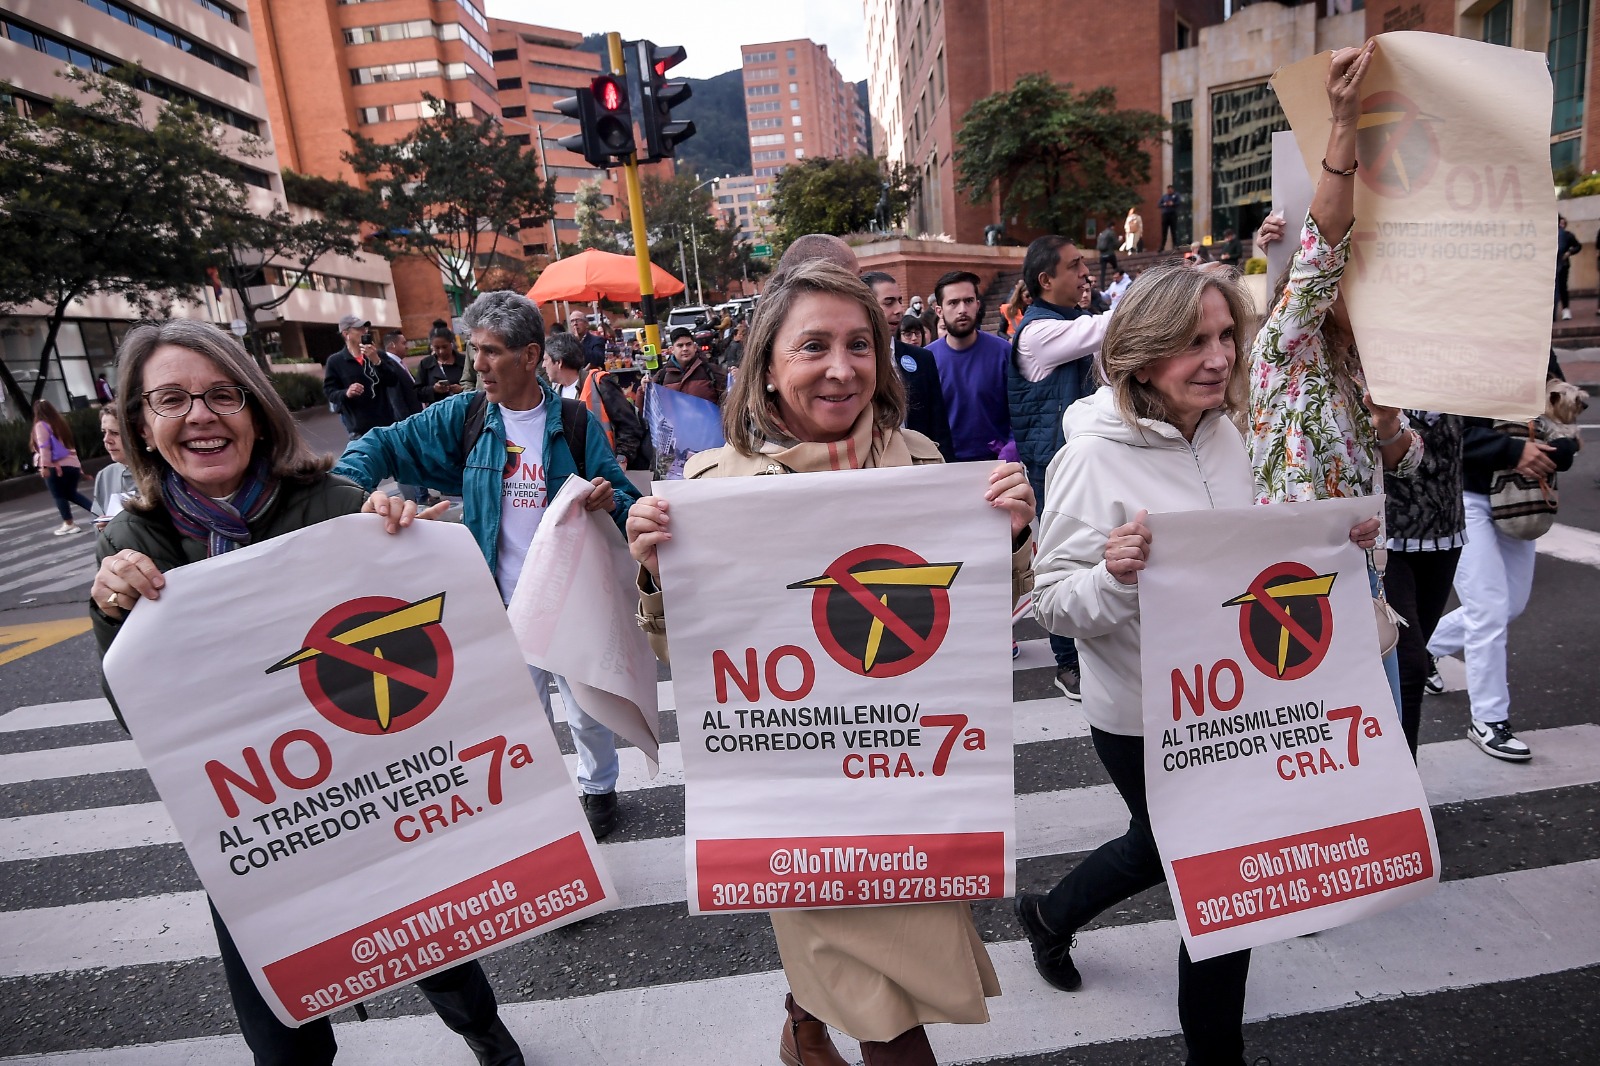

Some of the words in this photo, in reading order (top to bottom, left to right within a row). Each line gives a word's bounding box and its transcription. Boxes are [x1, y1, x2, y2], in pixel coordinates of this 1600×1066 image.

[512, 498, 539, 508] CRA.
[514, 490, 539, 498] VERDE
[712, 644, 816, 704] NO
[1170, 658, 1244, 722] NO
[702, 710, 731, 731] AL
[734, 702, 920, 729] TRANSMILENIO/
[705, 731, 836, 753] CORREDOR
[843, 728, 922, 749] VERDE
[1161, 727, 1184, 749] AL
[1185, 699, 1325, 743] TRANSMILENIO/
[842, 753, 925, 779] CRA.
[1163, 735, 1268, 772] CORREDOR
[1274, 722, 1333, 751] VERDE
[1276, 747, 1345, 781] CRA.
[205, 729, 333, 818] NO
[219, 826, 254, 854] AL
[253, 741, 454, 836] TRANSMILENIO/
[229, 809, 381, 876] CORREDOR
[381, 765, 469, 813] VERDE
[393, 794, 484, 843] CRA.
[769, 846, 928, 876] @NoTM7verde
[1240, 833, 1370, 883] @NoTM7verde
[712, 883, 751, 906] 302
[752, 882, 791, 904] 667
[794, 880, 844, 903] 2146
[857, 878, 896, 900] 319
[898, 877, 936, 899] 278
[939, 875, 990, 897] 5653
[1196, 896, 1234, 926] 302
[1231, 887, 1264, 918] 667
[1265, 878, 1311, 910] 2146
[1318, 868, 1353, 898] 319
[1350, 861, 1385, 890] 278
[1382, 851, 1423, 882] 5653
[300, 983, 349, 1012] 302
[344, 964, 386, 995] 667
[388, 941, 445, 979] 2146
[453, 919, 497, 951] 319
[495, 902, 537, 935] 278
[534, 878, 589, 917] 5653
[352, 879, 518, 964] @NoTM7verde
